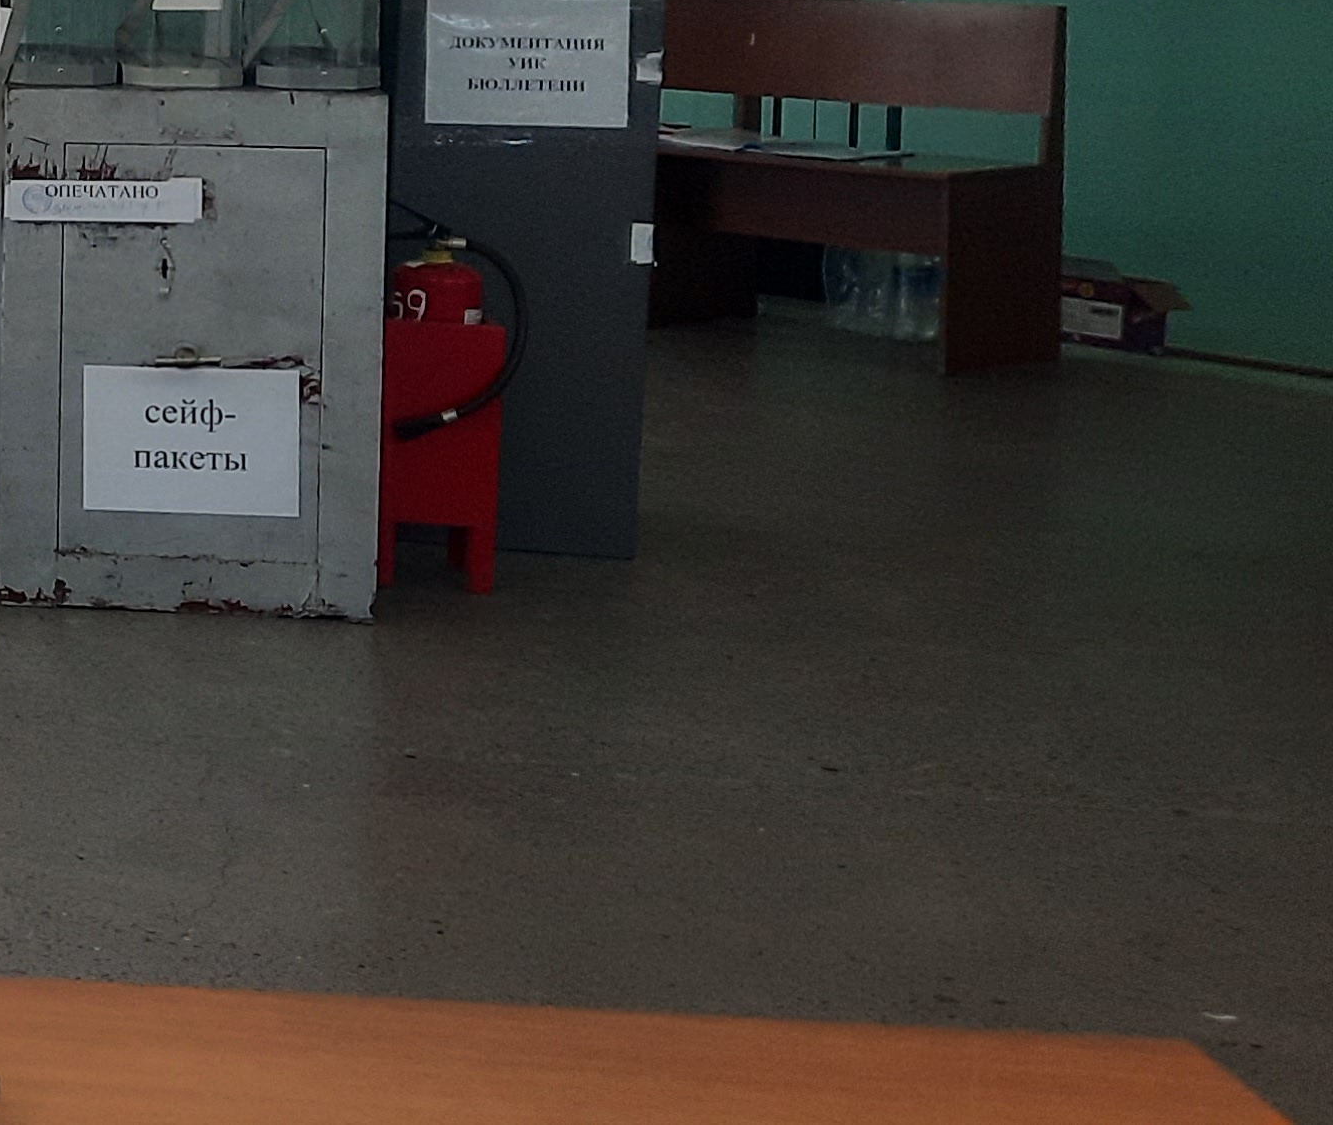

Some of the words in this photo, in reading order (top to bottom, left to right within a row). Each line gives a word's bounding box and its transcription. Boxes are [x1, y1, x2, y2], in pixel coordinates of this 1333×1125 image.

[449, 36, 605, 51] ДОКУМЕНТАЦИЯ
[508, 57, 547, 70] УИК
[468, 78, 586, 92] БЮЛЛЕТЕНИ
[45, 184, 159, 199] ОПЕЧАТАНО
[145, 399, 237, 433] сейф-
[134, 449, 249, 472] пакеты
